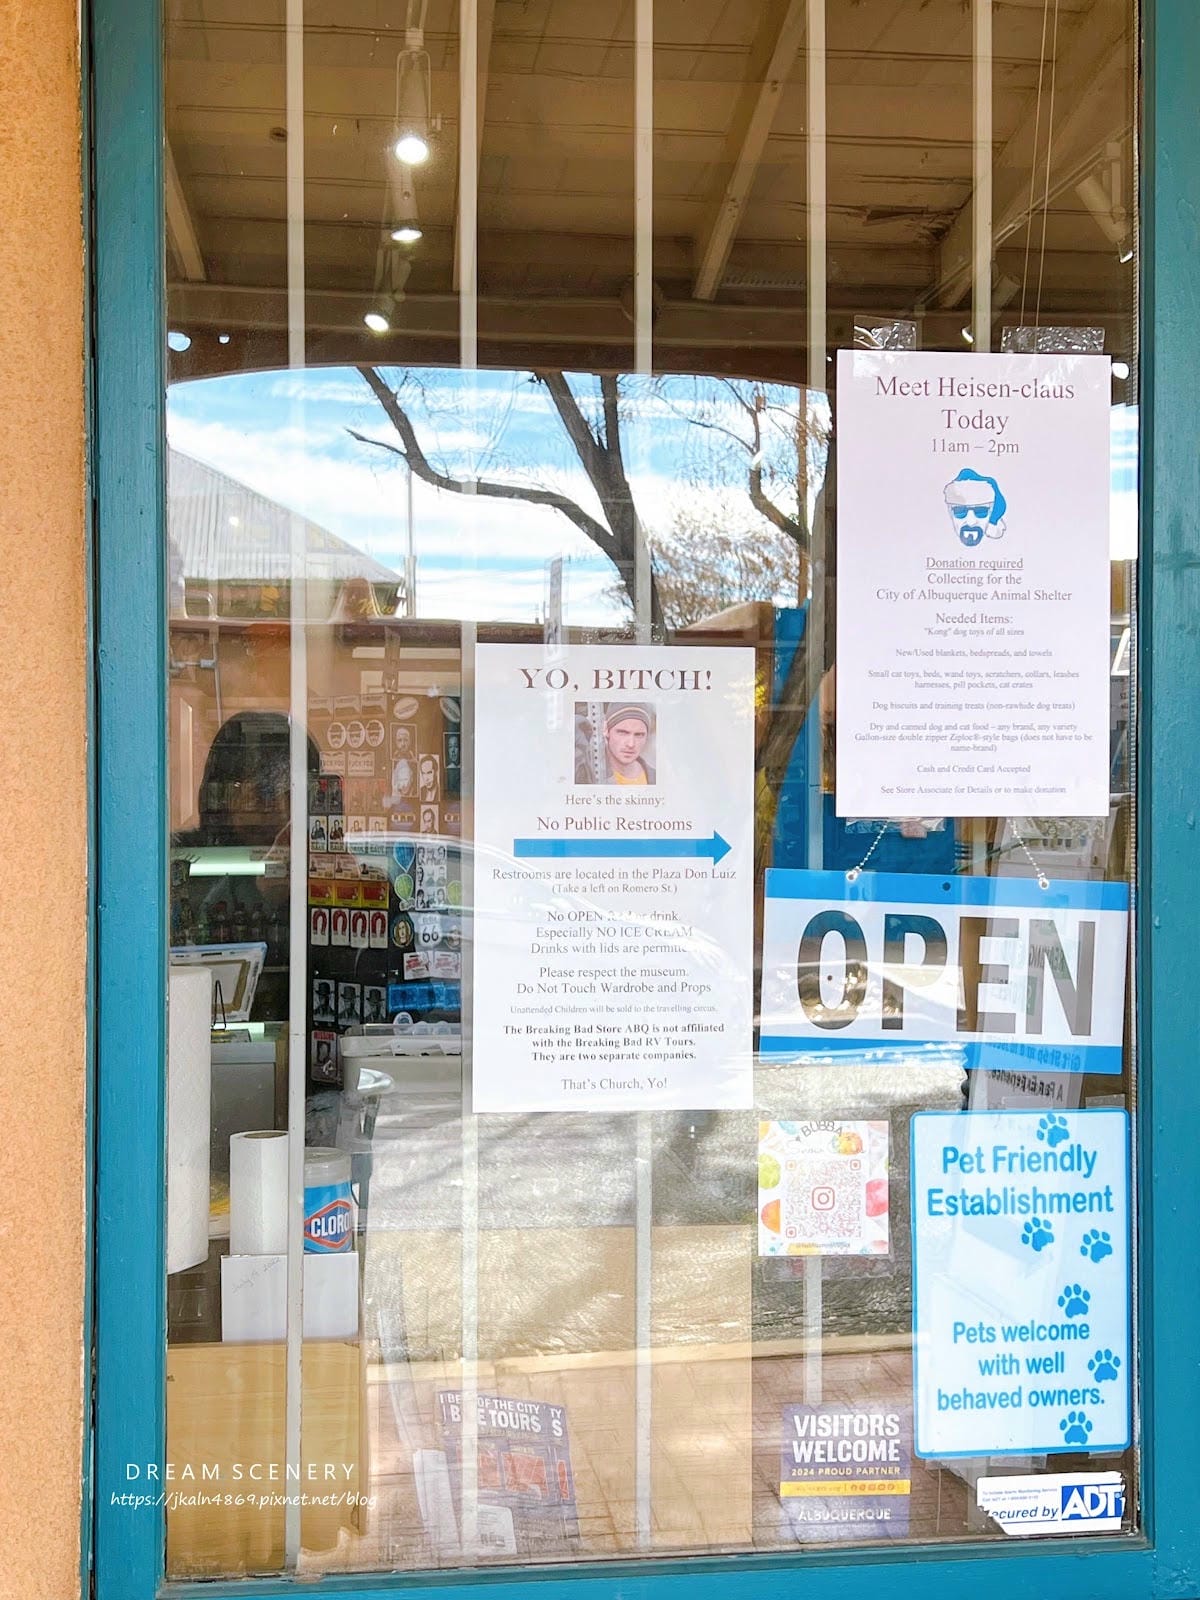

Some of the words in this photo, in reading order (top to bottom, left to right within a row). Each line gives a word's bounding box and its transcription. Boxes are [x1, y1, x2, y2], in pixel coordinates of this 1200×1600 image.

[876, 376, 930, 396] Meet
[938, 377, 1074, 399] Heisen-claus
[942, 410, 1009, 434] Today
[932, 439, 969, 453] 11am
[988, 440, 1019, 456] 2pm
[926, 557, 976, 569] Donation
[979, 558, 1023, 570] required
[928, 574, 983, 587] Collecting
[987, 574, 1002, 585] for
[1006, 574, 1022, 585] the
[877, 588, 899, 601] City
[904, 588, 915, 600] of
[918, 588, 987, 601] Albuquerque
[991, 588, 1031, 600] Animal
[1033, 588, 1072, 601] Shelter
[936, 613, 976, 624] Needed
[980, 613, 1013, 624] Items:
[519, 668, 580, 691] YO,
[593, 669, 712, 690] BITCH!
[565, 795, 601, 805] Here's
[606, 795, 622, 805] the
[625, 795, 665, 808] skinny:
[538, 817, 559, 830] No
[565, 817, 610, 830] Public
[616, 817, 692, 831] Restrooms
[493, 869, 551, 880] Restrooms
[576, 868, 614, 879] located
[619, 869, 628, 879] in
[632, 869, 649, 879] the
[652, 868, 681, 879] Plaza
[685, 869, 707, 879] Don
[712, 868, 736, 879] Luiz
[552, 883, 579, 894] (Take
[590, 883, 605, 893] left
[622, 884, 658, 893] Romero
[548, 912, 564, 921] No
[568, 912, 603, 921] OPEN
[422, 925, 439, 942] 66
[536, 927, 592, 939] Especially
[597, 927, 616, 937] NO
[620, 927, 641, 937] ICE
[645, 927, 693, 937] CREAM
[531, 944, 568, 954] Drinks
[572, 944, 596, 953] with
[600, 944, 619, 953] lids
[539, 967, 574, 978] Please
[578, 968, 617, 979] respect
[620, 967, 637, 977] the
[641, 969, 689, 977] museum.
[797, 909, 1096, 1037] OPEN
[517, 983, 533, 994] Do
[537, 983, 557, 994] Not
[562, 983, 596, 994] Touch
[600, 982, 654, 993] Wardrobe
[658, 982, 677, 992] and
[681, 982, 711, 995] Props
[503, 1026, 522, 1034] The
[526, 1025, 570, 1035] Breaking
[574, 1024, 593, 1034] Bad
[596, 1024, 622, 1033] Store
[626, 1024, 649, 1034] ABQ
[653, 1024, 660, 1032] is
[663, 1024, 678, 1032] not
[680, 1023, 724, 1032] affiliated
[532, 1038, 553, 1047] with
[557, 1038, 572, 1047] the
[576, 1038, 620, 1050] Breaking
[624, 1038, 642, 1046] Bad
[646, 1037, 661, 1046] RV
[664, 1037, 695, 1047] Tours.
[532, 1052, 556, 1063] They
[578, 1053, 596, 1061] two
[599, 1052, 640, 1062] separate
[643, 1051, 696, 1062] companies.
[562, 1078, 596, 1090] That's
[600, 1078, 643, 1090] Church,
[647, 1078, 667, 1088] Yo!
[942, 1146, 985, 1174] Pet
[993, 1144, 1097, 1179] Friendly
[928, 1185, 1113, 1216] Establishment
[953, 1322, 996, 1343] Pets
[1002, 1320, 1090, 1342] welcome
[979, 1353, 1019, 1376] with
[1026, 1352, 1064, 1374] well
[938, 1385, 1022, 1410] behaved
[1029, 1387, 1105, 1408] owners.
[478, 1397, 491, 1408] OF
[493, 1399, 514, 1410] THE
[517, 1402, 539, 1414] CITY
[489, 1410, 541, 1433] TOURS
[794, 1414, 899, 1436] VISITORS
[793, 1439, 900, 1463] WELCOME
[792, 1468, 814, 1476] 2024
[857, 1467, 900, 1475] PARTNER
[992, 1506, 1038, 1519] ecured
[1042, 1507, 1058, 1519] by
[1062, 1486, 1122, 1519] ADT
[799, 1509, 891, 1521] ALBUQUERQUE
